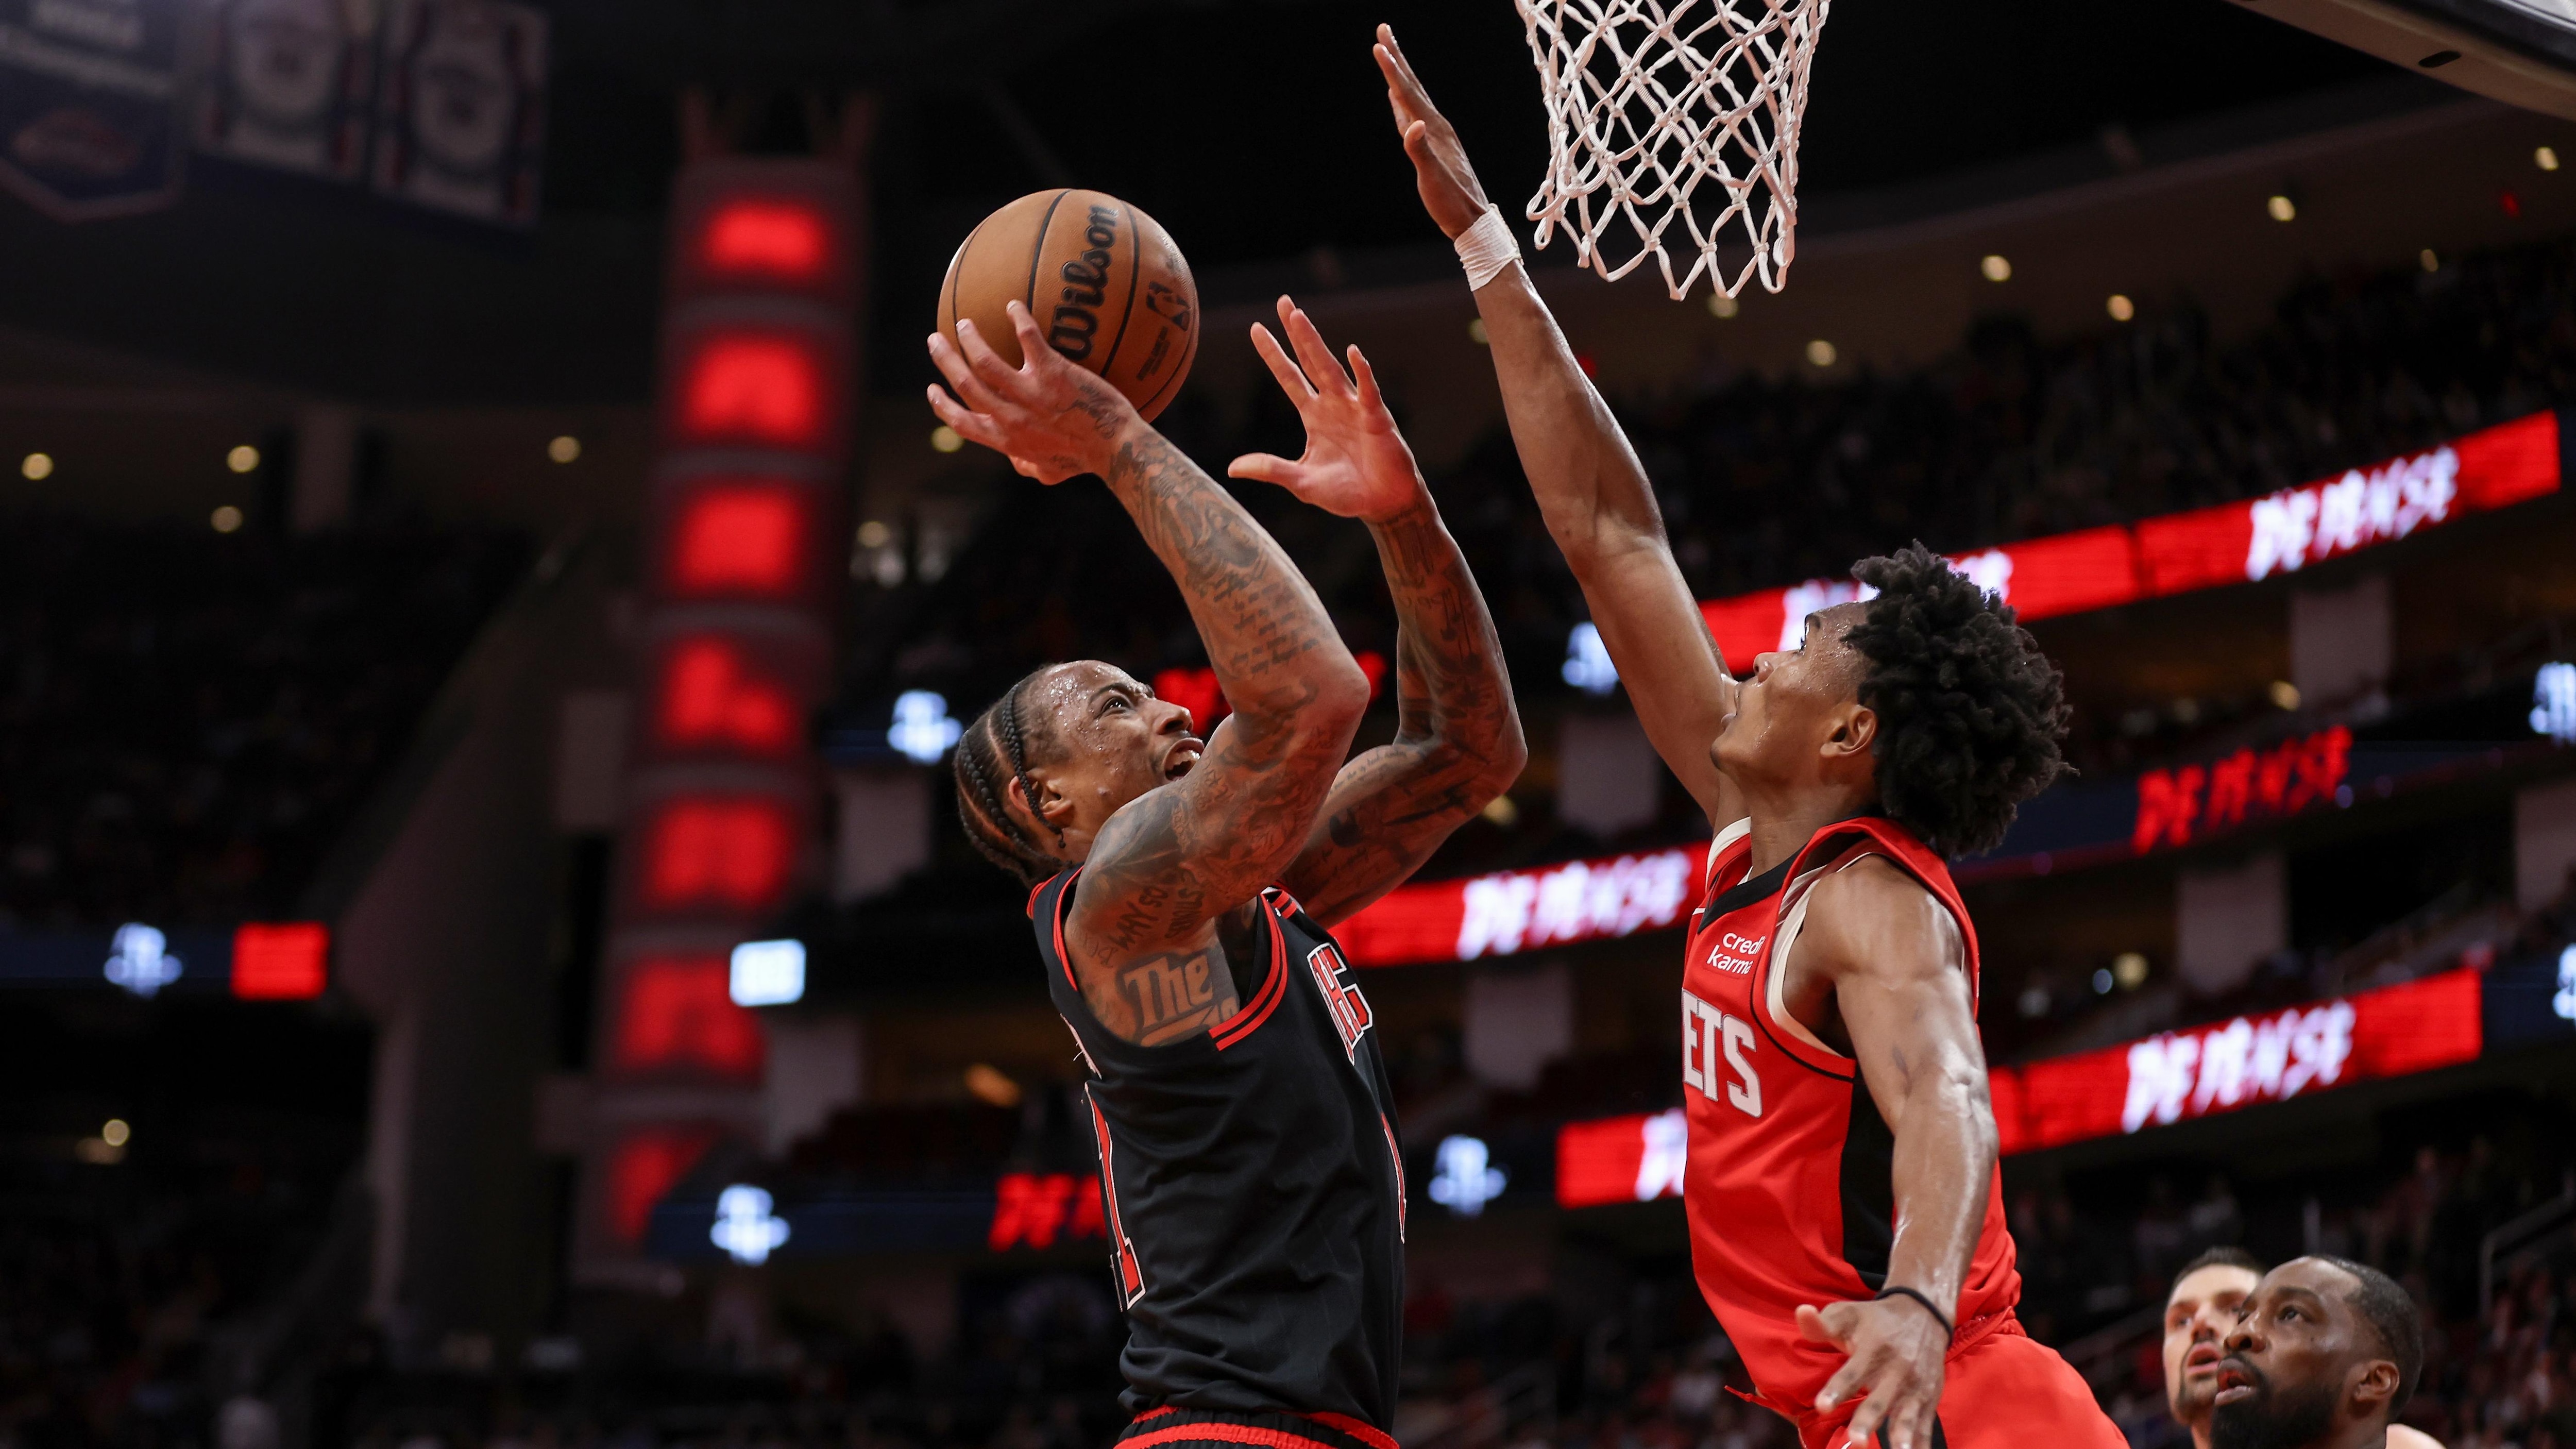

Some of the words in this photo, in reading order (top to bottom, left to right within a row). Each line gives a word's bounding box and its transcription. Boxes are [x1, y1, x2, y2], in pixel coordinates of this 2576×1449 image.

[1049, 204, 1120, 361] Wilson
[1723, 932, 1766, 955] credi
[1123, 956, 1213, 1028] The
